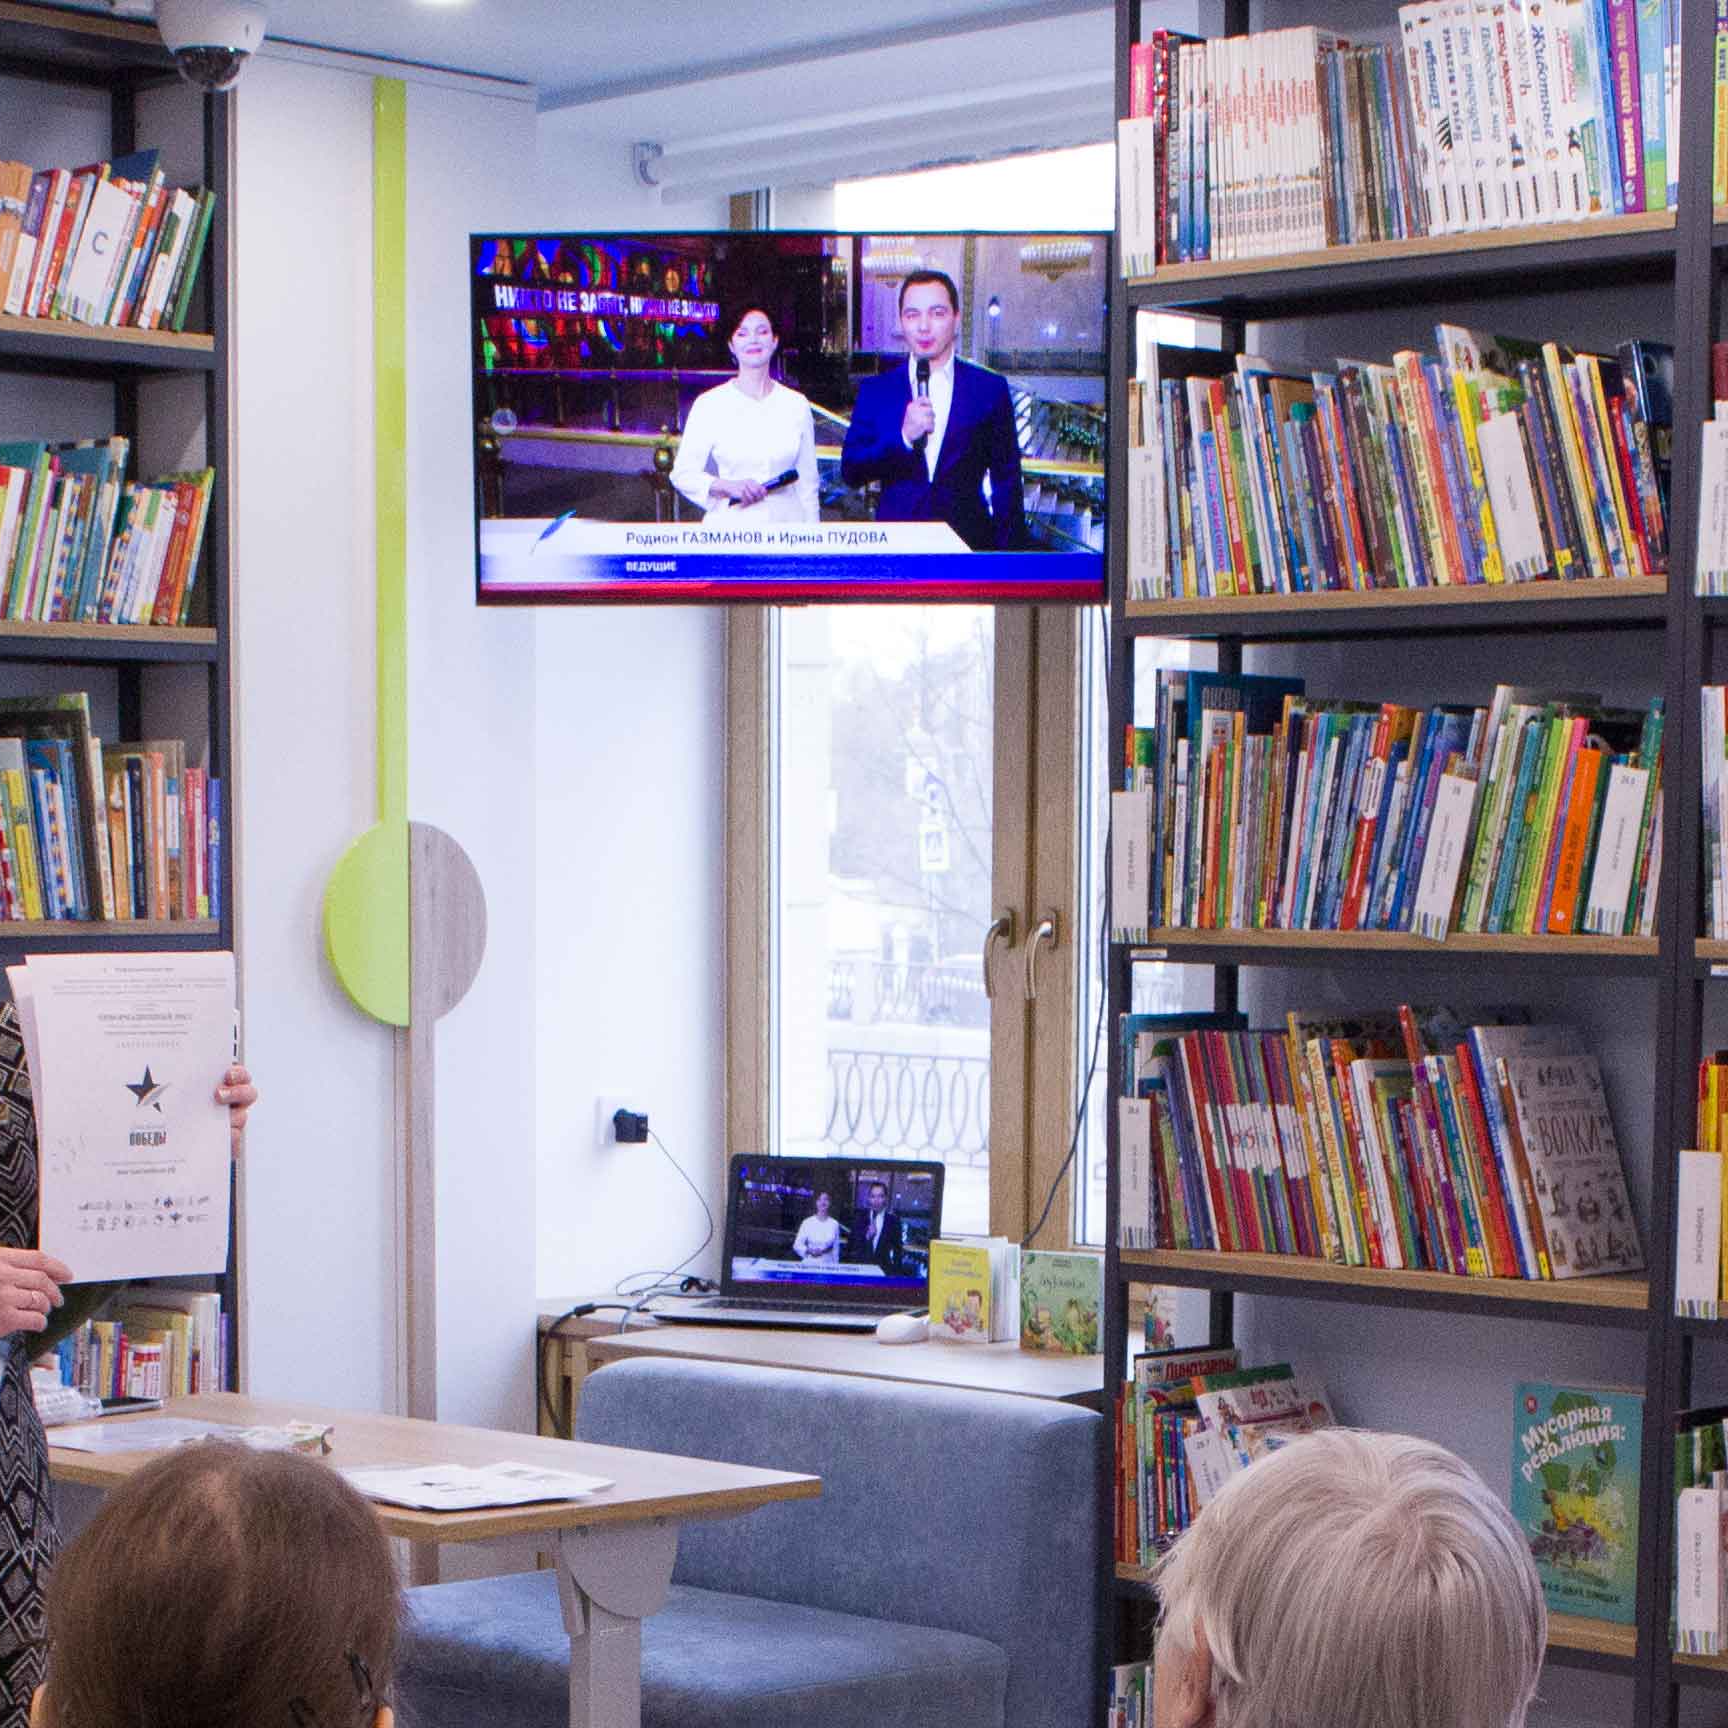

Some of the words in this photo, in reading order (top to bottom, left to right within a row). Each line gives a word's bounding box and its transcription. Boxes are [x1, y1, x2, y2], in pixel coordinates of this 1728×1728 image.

[91, 231, 110, 255] С
[557, 290, 577, 312] НЕ
[626, 531, 678, 546] Родион
[682, 531, 763, 545] ГАЗМАНОВ
[767, 534, 775, 544] и
[779, 531, 823, 546] Ирина
[827, 531, 889, 546] ПУДОВА
[626, 560, 677, 574] ВЕДУЩИЕ
[1521, 1405, 1614, 1453] Мусорная
[1521, 1422, 1627, 1482] революция:
